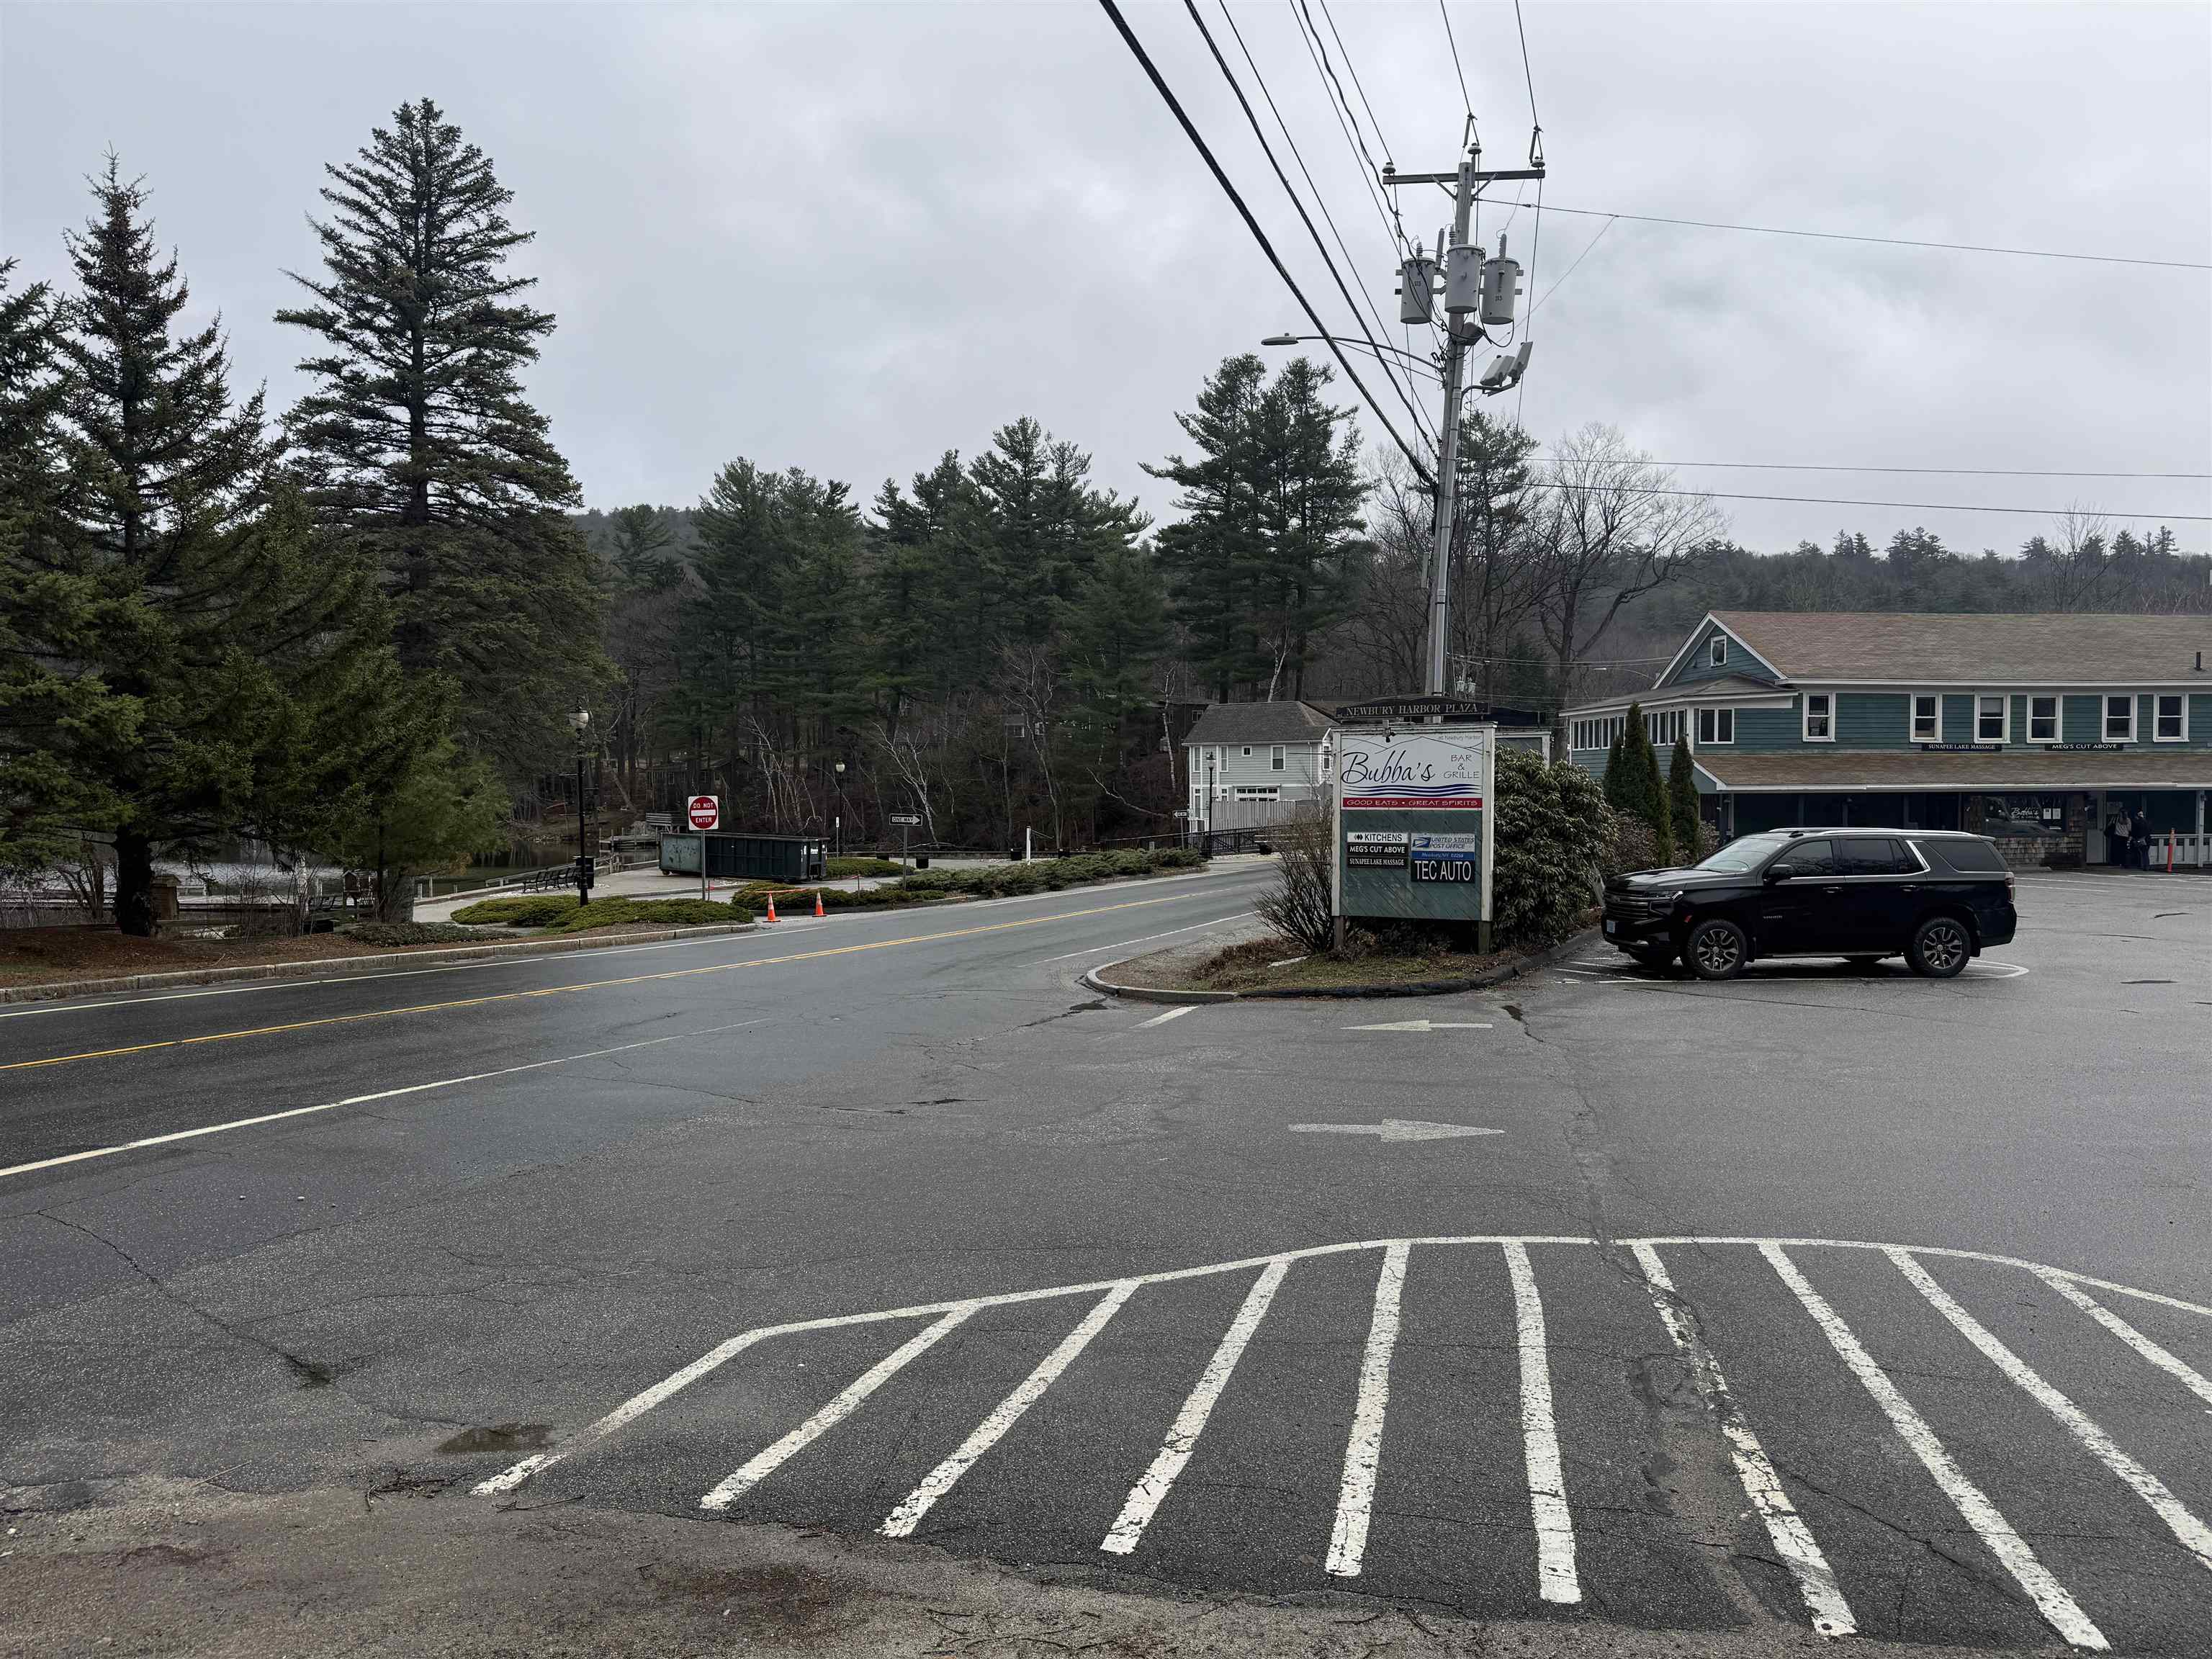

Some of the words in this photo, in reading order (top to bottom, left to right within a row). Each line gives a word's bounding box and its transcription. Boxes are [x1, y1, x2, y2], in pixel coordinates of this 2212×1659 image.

[1346, 706, 1395, 716] NEWBURY
[1399, 704, 1441, 714] HARBOR
[1445, 703, 1478, 712] PLAZA
[1341, 750, 1435, 784] Bubba's
[1414, 860, 1437, 880] TEC
[1440, 861, 1472, 881] AUTO
